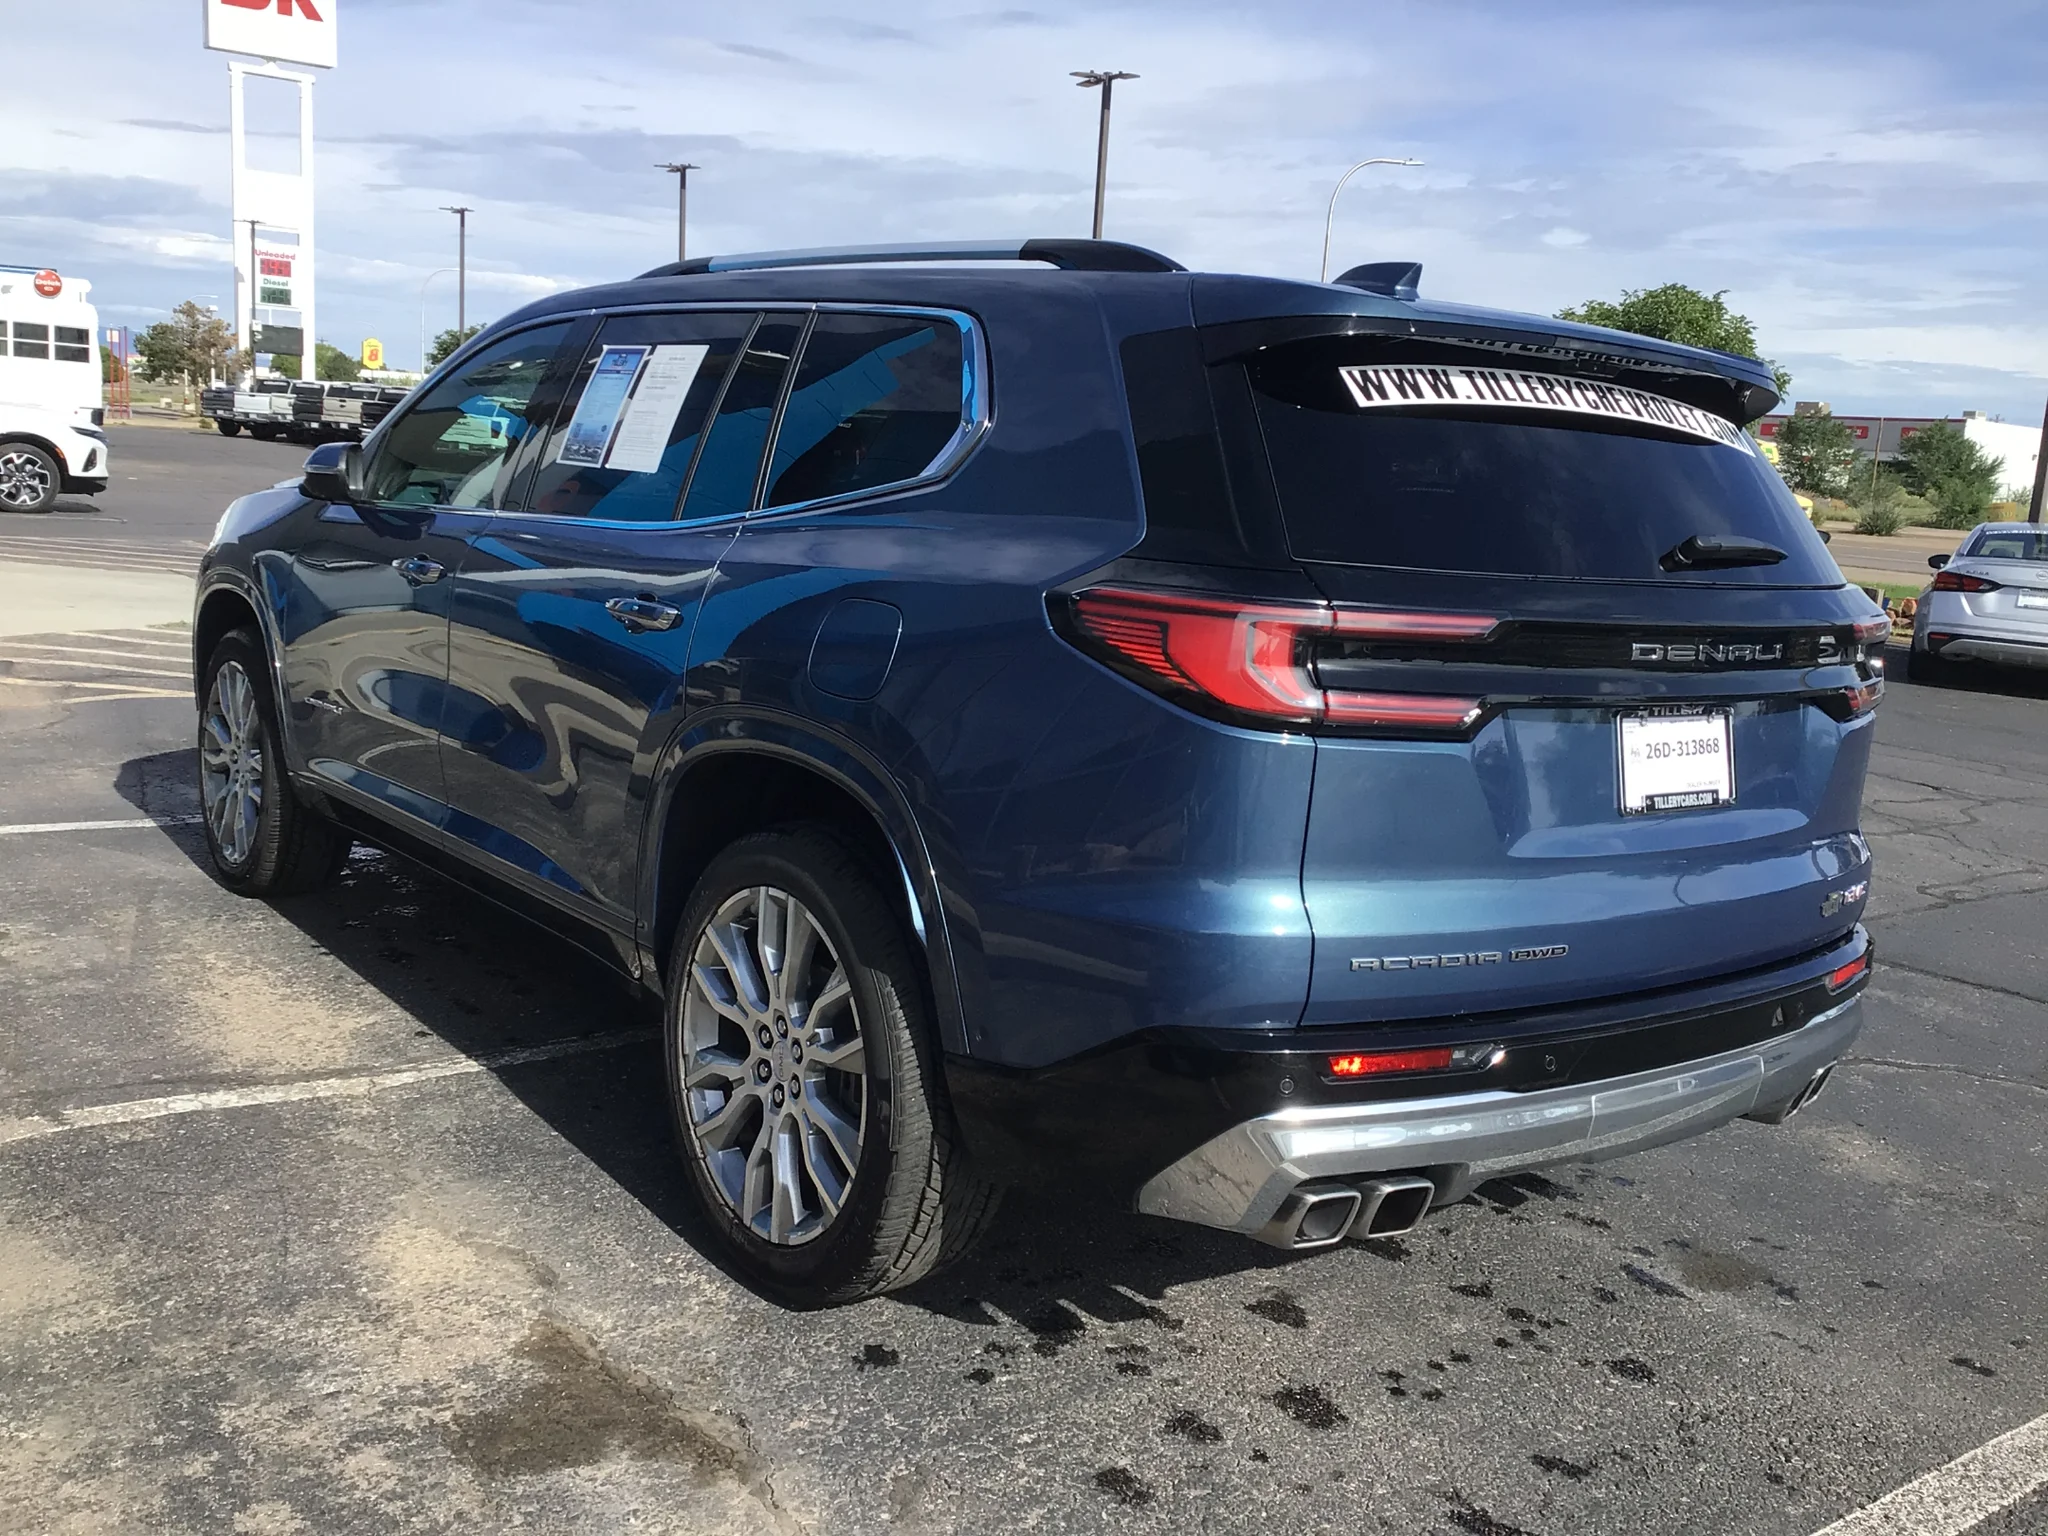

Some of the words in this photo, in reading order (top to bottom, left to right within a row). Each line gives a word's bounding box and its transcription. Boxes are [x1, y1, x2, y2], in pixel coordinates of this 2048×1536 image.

[254, 249, 296, 260] Unleaded
[263, 278, 288, 287] Diesel
[1346, 367, 1752, 453] WWW.TILLERYCHEVROLET.COM
[1631, 643, 1783, 662] DENALI
[1645, 737, 1720, 759] 26D-313868
[1654, 792, 1713, 809] TILLERYCARS.COM
[1350, 951, 1502, 971] ACADIA
[1511, 945, 1568, 962] AWD
